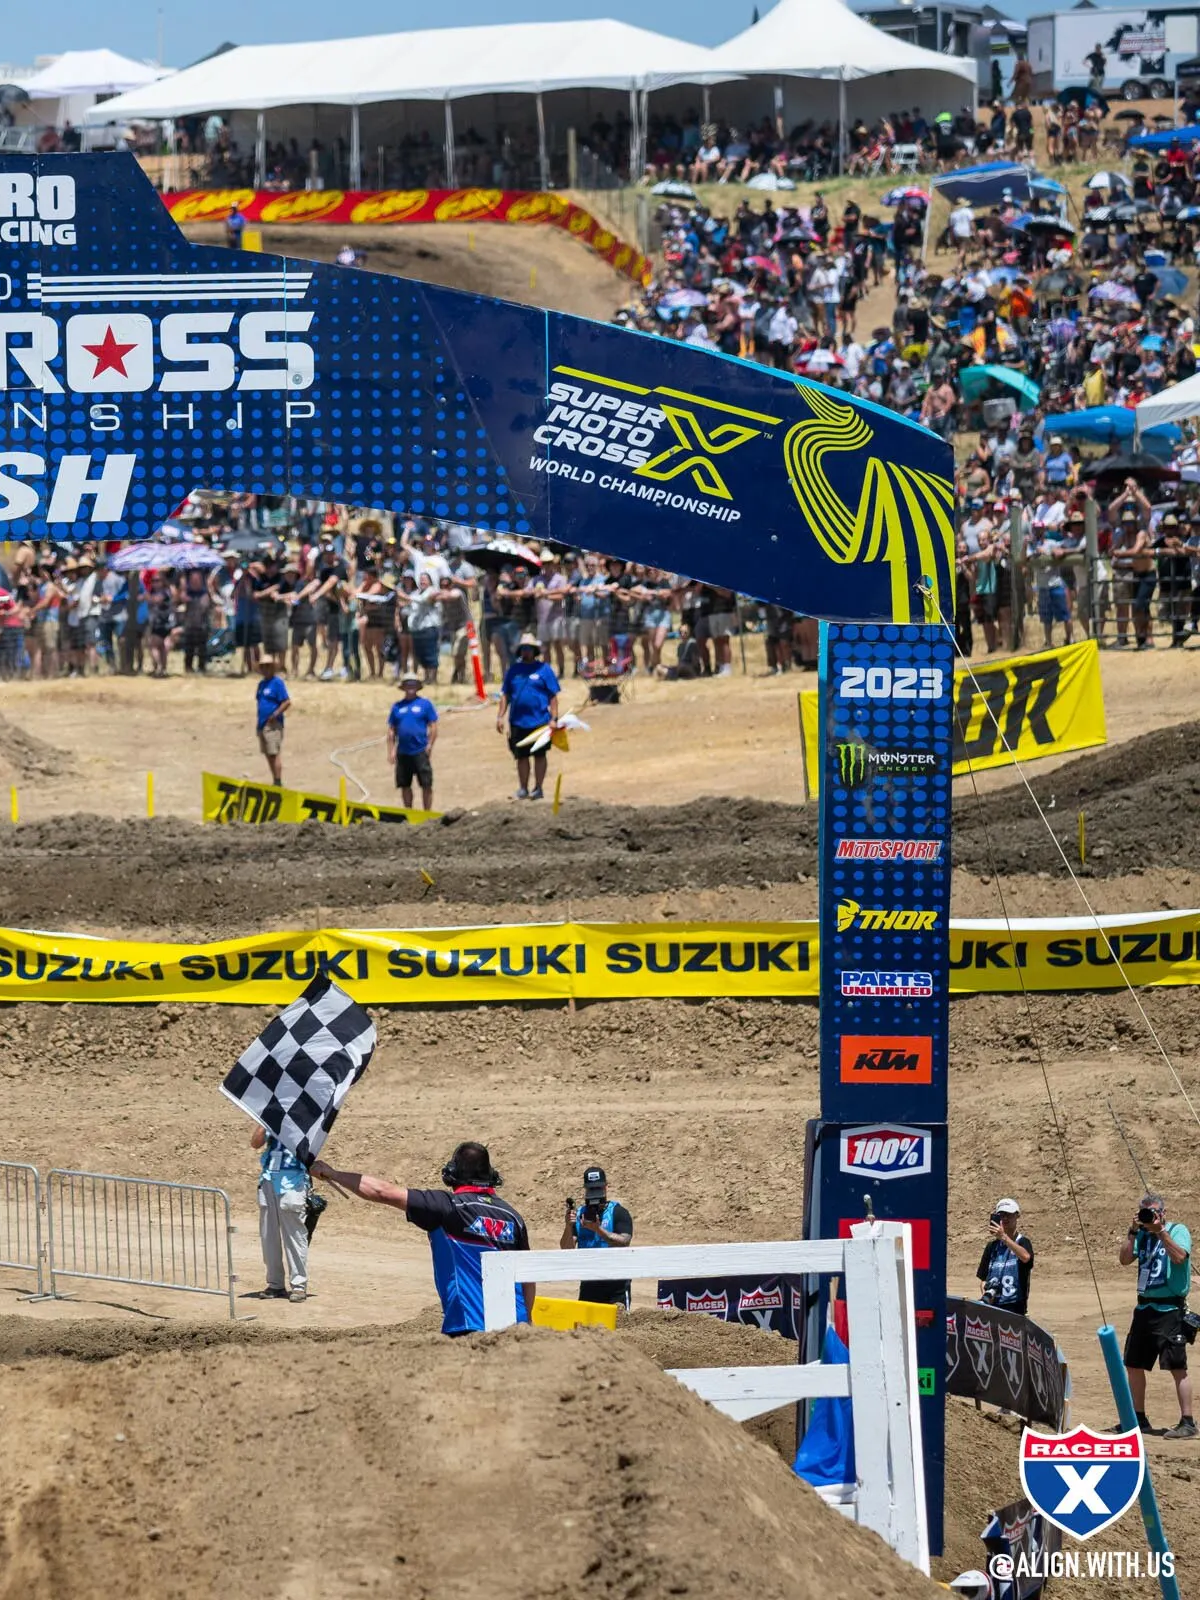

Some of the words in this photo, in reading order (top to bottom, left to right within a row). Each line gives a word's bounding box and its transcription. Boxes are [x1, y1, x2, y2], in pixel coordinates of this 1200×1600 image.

[545, 382, 667, 429] SUPER
[546, 405, 655, 448] MOTO
[533, 425, 652, 468] CROSS
[529, 456, 596, 484] WORLD
[598, 474, 742, 523] CHAMPIONSHIP
[840, 667, 943, 699] 2023
[952, 657, 1061, 762] OR
[868, 752, 936, 765] MONSTER
[859, 909, 939, 931] THOR
[180, 948, 369, 982] SUZUKI
[388, 944, 587, 979] SUZUKI
[606, 940, 810, 973] SUZUKI
[949, 940, 1028, 969] UKI
[1046, 930, 1200, 967] SUZU
[843, 971, 932, 986] PARTS
[843, 986, 932, 996] UNLIMITED
[853, 1048, 920, 1071] KTM
[852, 1137, 920, 1166] 100%
[690, 1300, 725, 1310] RACER
[742, 1296, 779, 1307] RACER
[966, 1326, 991, 1339] RACER
[1001, 1335, 1022, 1348] RACER
[972, 1341, 990, 1375] X
